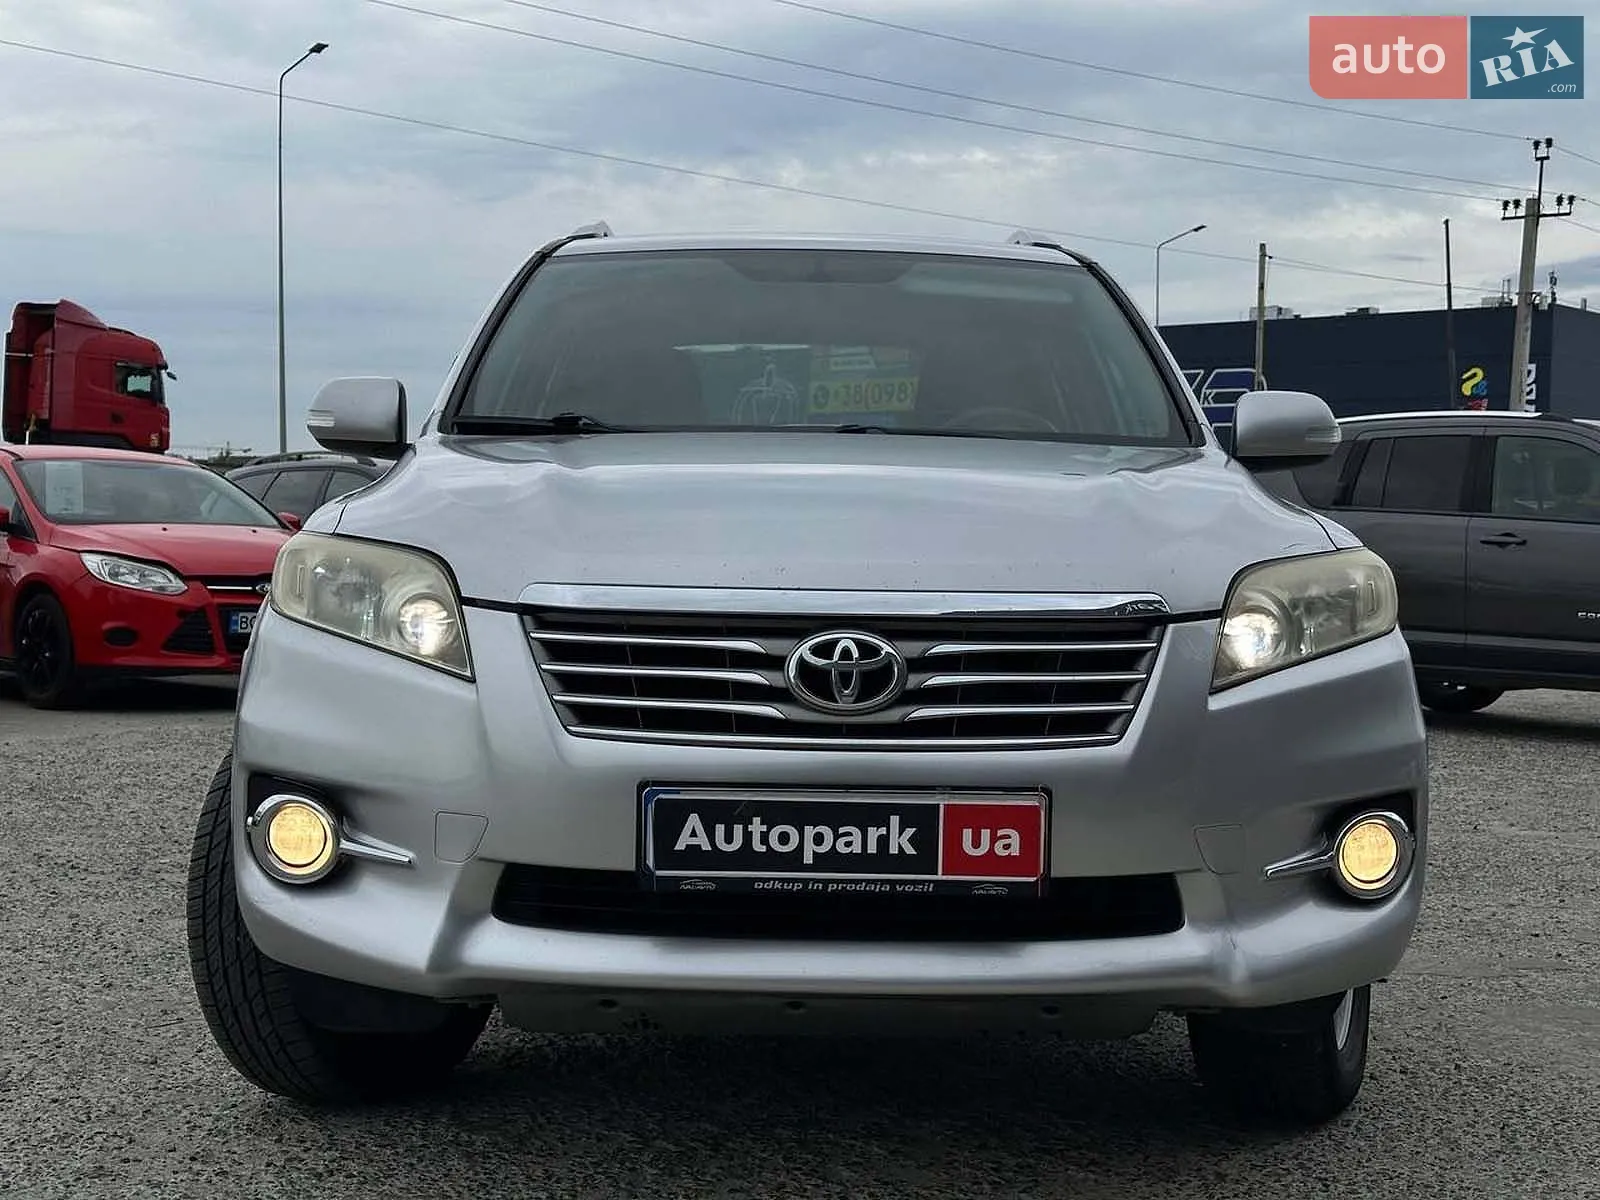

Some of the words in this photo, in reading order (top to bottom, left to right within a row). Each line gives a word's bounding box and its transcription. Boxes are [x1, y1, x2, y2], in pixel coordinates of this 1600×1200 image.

[673, 812, 918, 864] Autopark
[961, 827, 1020, 857] ua
[753, 880, 804, 892] odkup
[807, 881, 823, 890] in
[827, 881, 890, 893] prodaja
[895, 883, 934, 892] vozil
